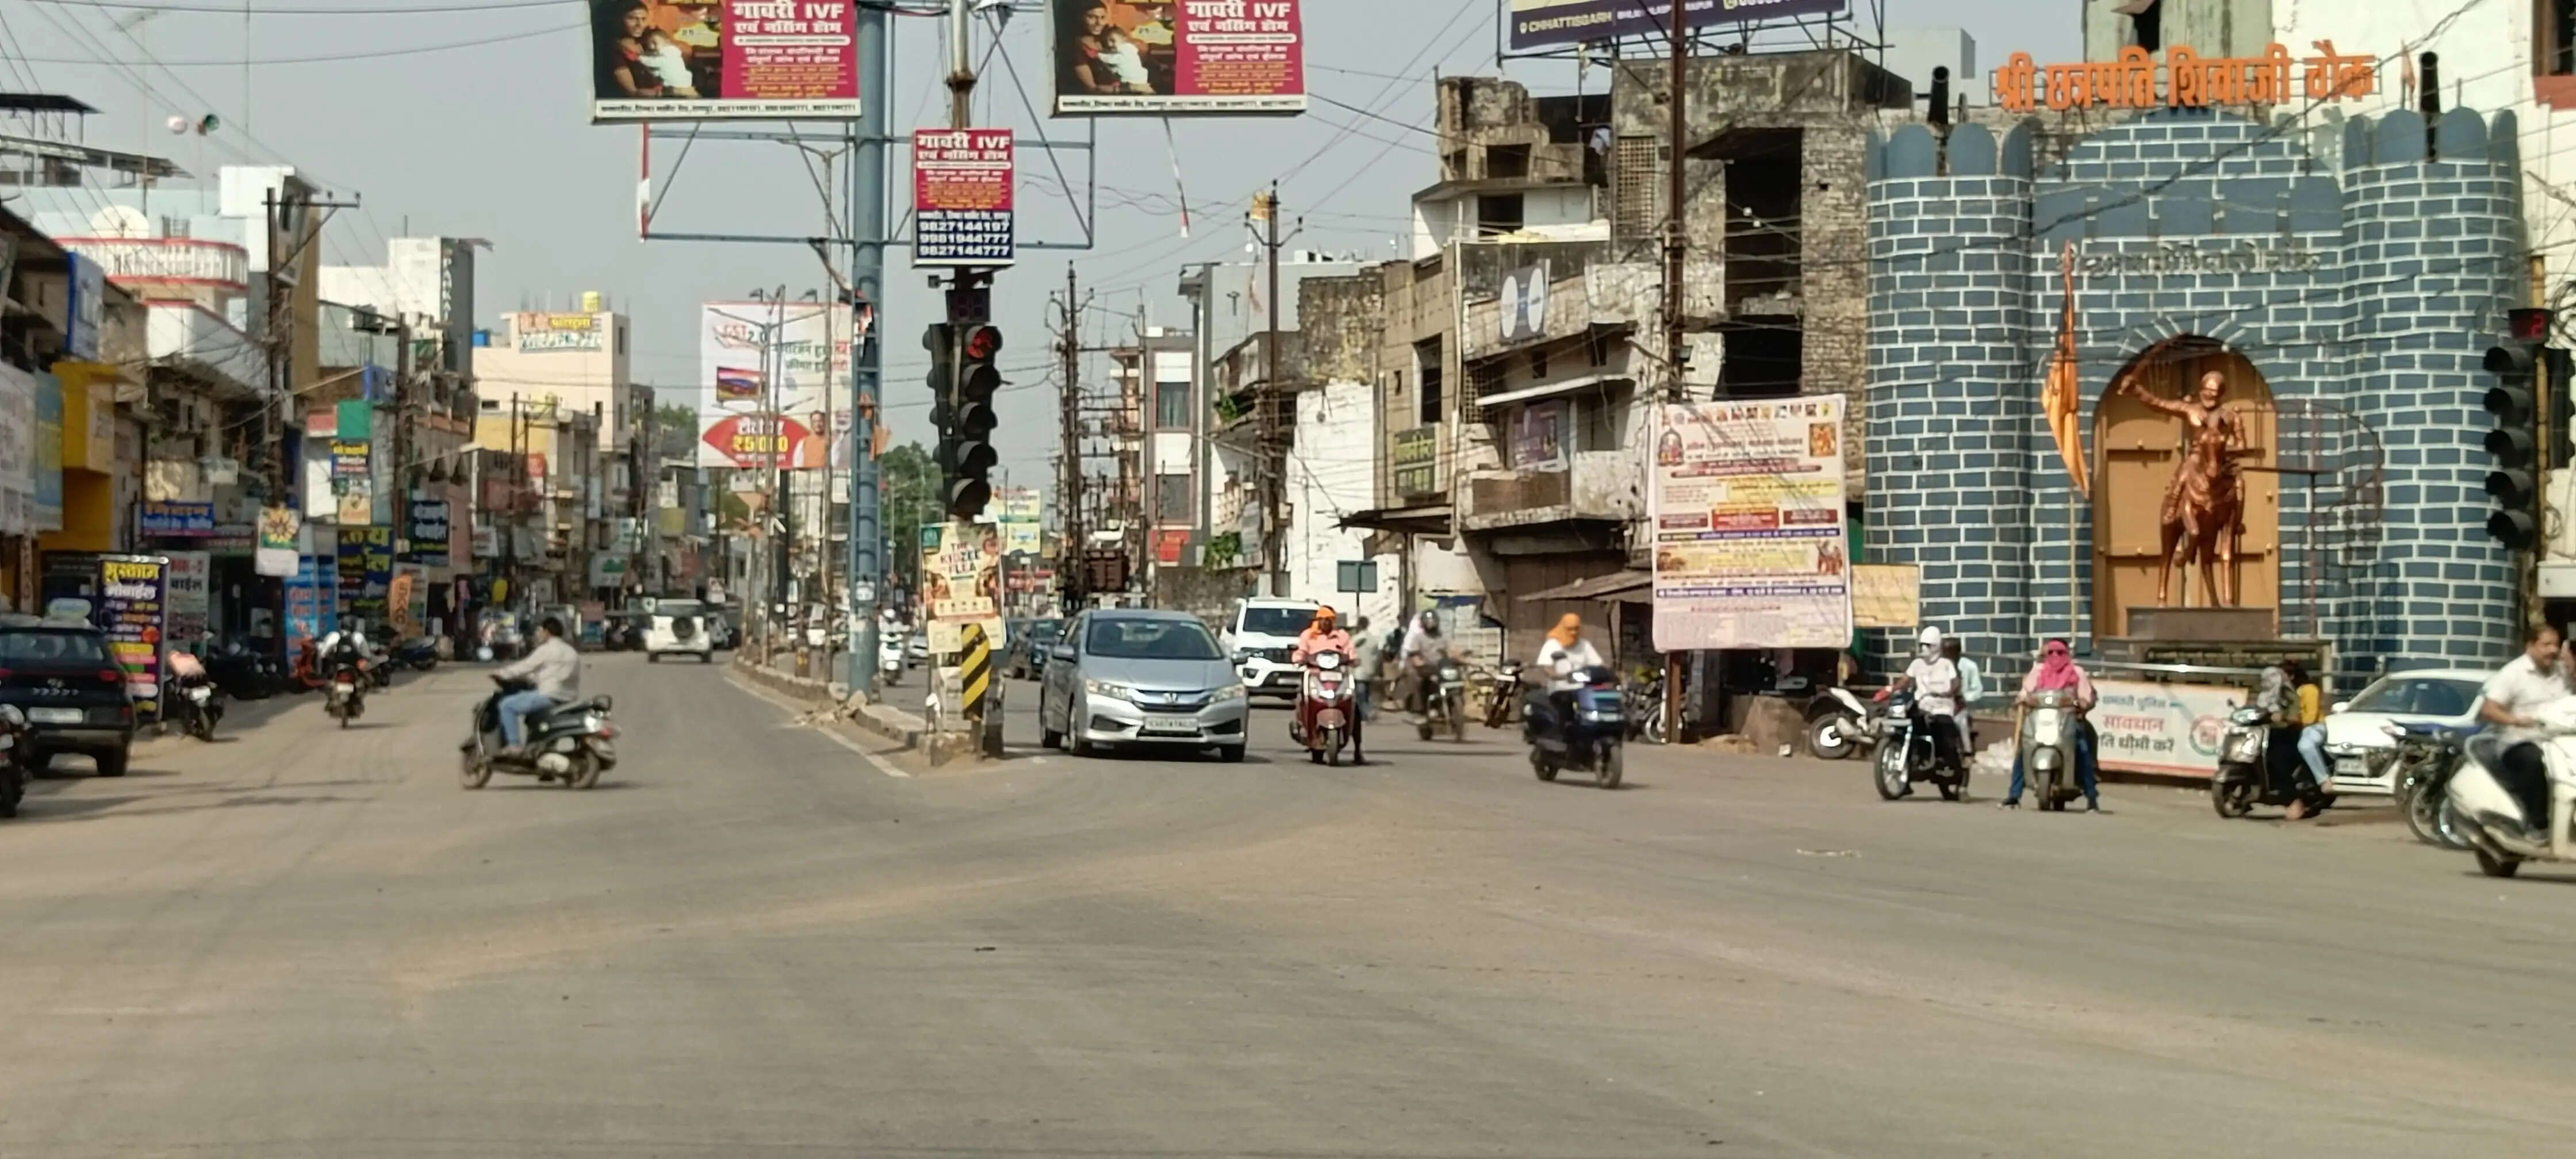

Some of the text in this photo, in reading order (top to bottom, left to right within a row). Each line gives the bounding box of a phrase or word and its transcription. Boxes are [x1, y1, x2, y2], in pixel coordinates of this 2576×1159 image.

[804, 3, 844, 18] IVF
[1254, 3, 1291, 18] IVF
[1528, 11, 1612, 32] CHHATTISGARH
[1996, 39, 2376, 113] श्री छत्रपति शिवाजी चौक
[977, 136, 1010, 148] IVF
[2102, 714, 2165, 731] सावधान
[2099, 731, 2175, 756] ति धीमी करें
